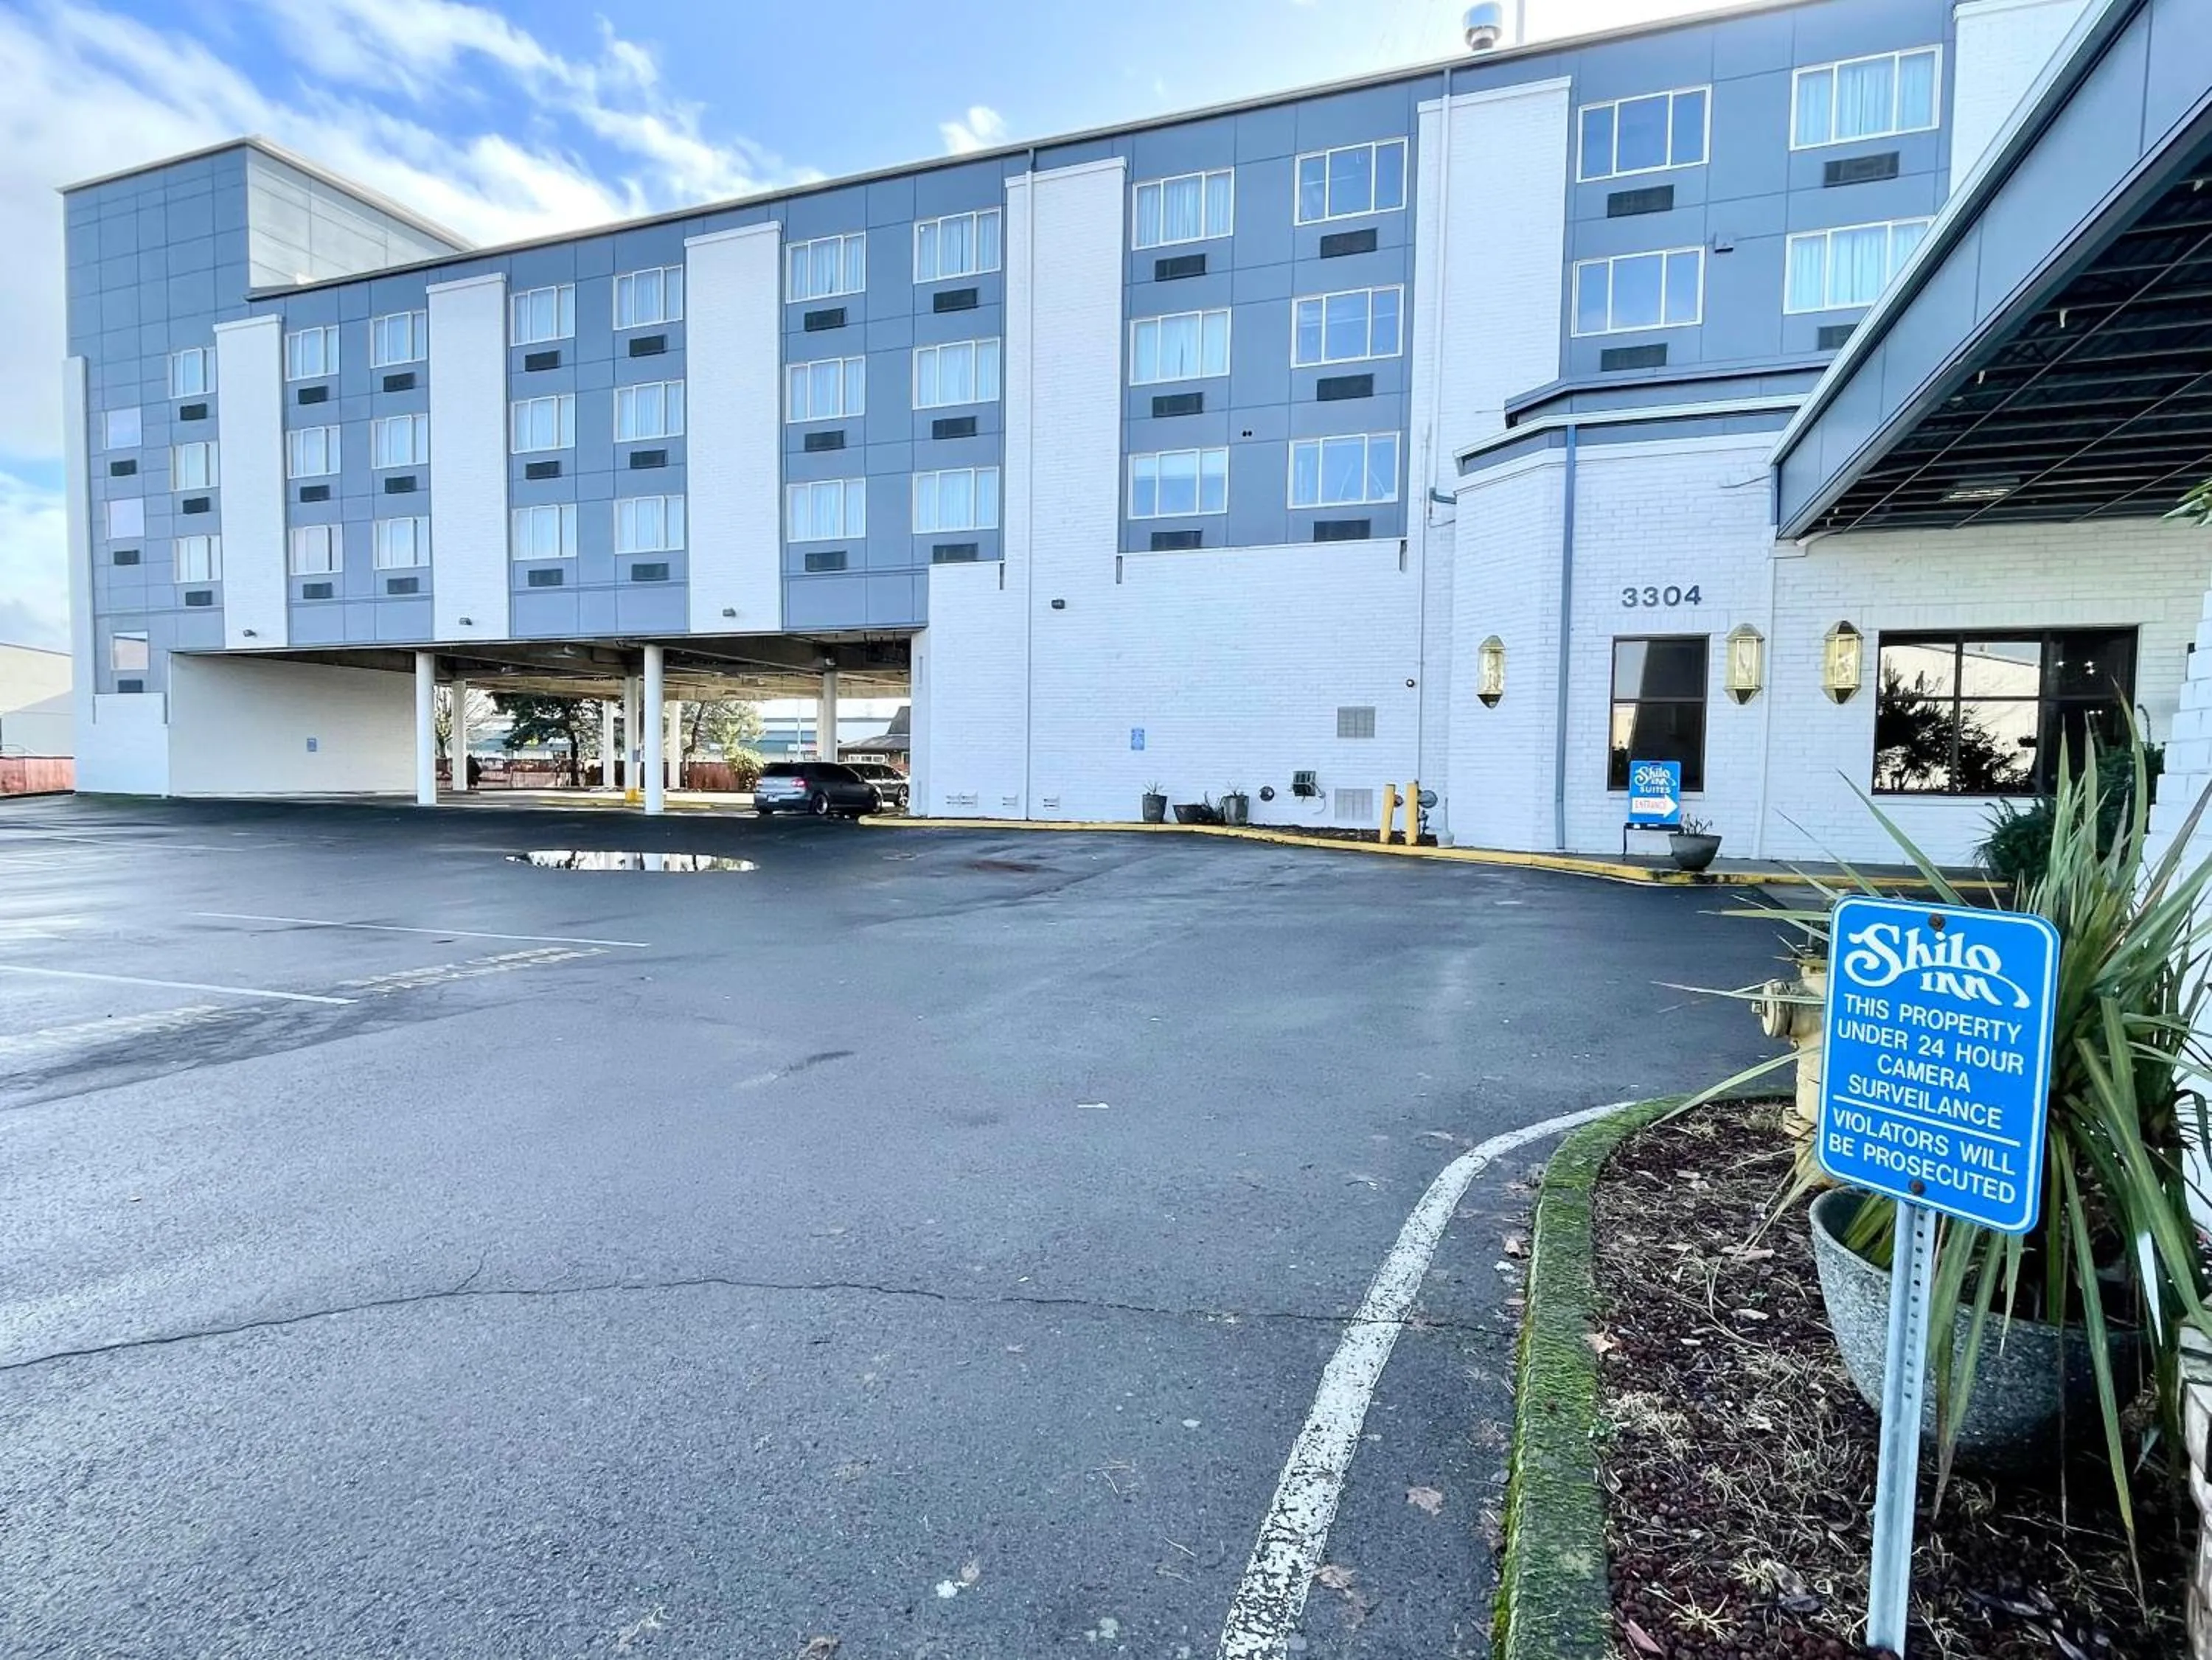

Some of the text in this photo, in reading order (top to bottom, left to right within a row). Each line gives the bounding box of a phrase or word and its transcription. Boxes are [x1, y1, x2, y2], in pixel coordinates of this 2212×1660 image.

[1622, 585, 1701, 607] 3304
[1635, 766, 1677, 787] Shilo
[1639, 786, 1671, 794] SUITES
[1844, 923, 2031, 1008] Shilo
[1844, 993, 2023, 1045] THIS PROPERTY
[1837, 1018, 2025, 1076] UNDER 24 HOUR
[1877, 1053, 1970, 1093] CAMERA
[1848, 1075, 2003, 1131] SURVEILANCE
[1829, 1133, 2017, 1205] BE PROSECUTED
[1833, 1108, 2017, 1176] VIOLATORS WILL
